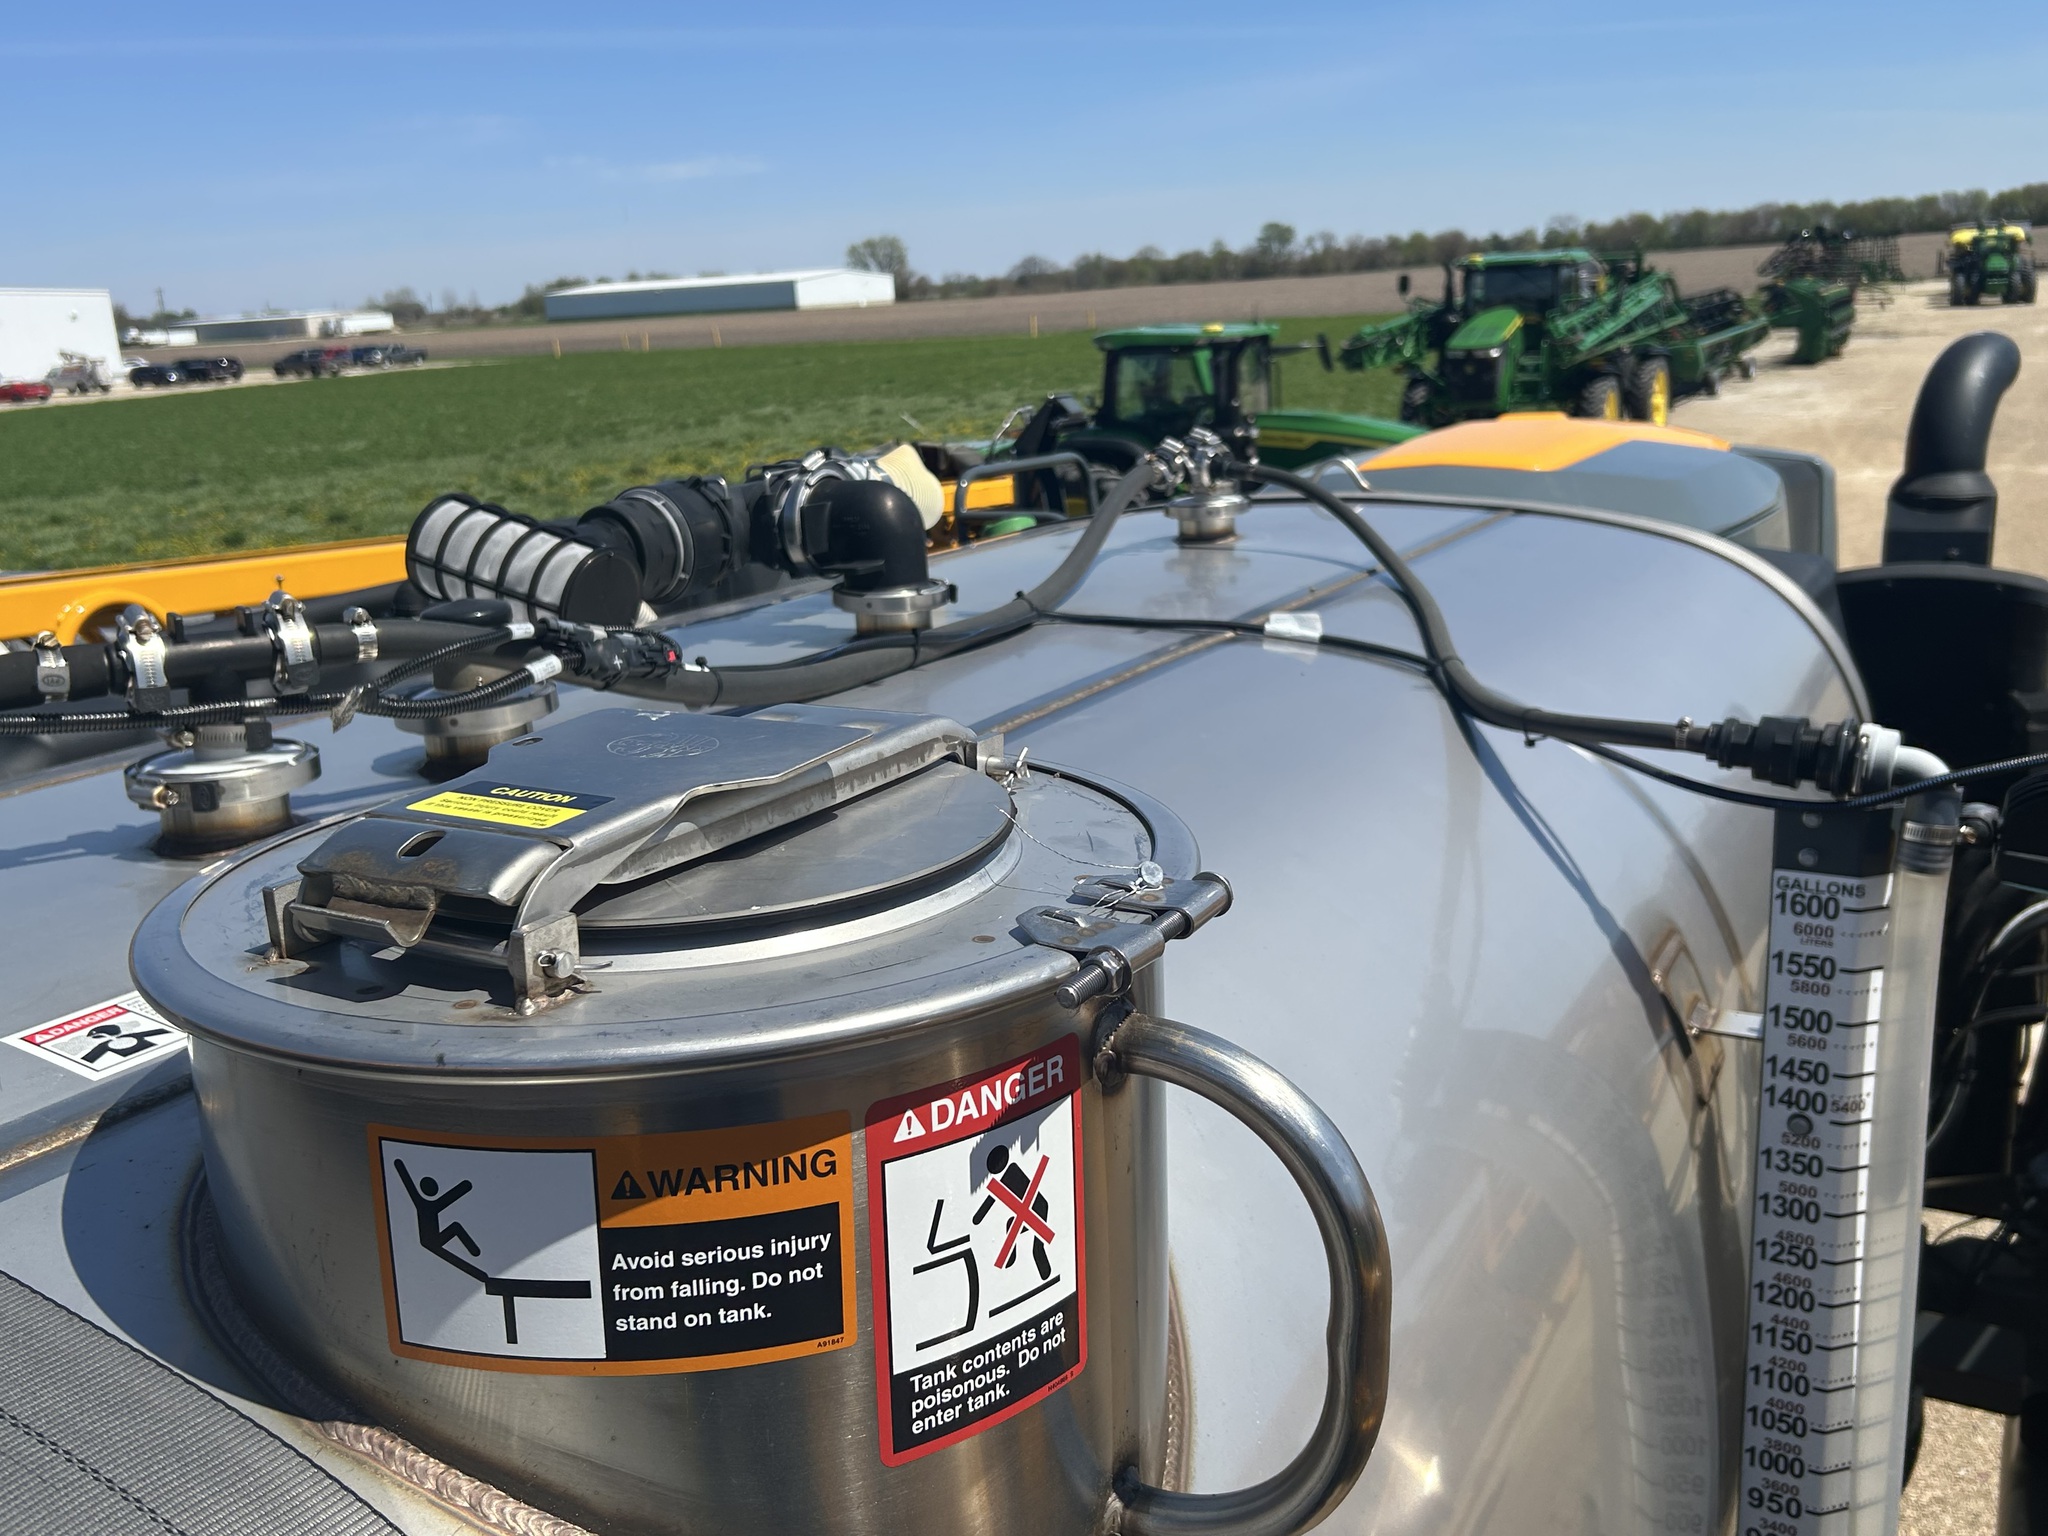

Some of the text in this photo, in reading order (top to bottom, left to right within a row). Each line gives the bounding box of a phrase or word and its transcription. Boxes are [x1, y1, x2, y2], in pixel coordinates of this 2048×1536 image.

[479, 798, 525, 808] PRESSURE
[526, 804, 561, 813] COVER
[490, 786, 577, 804] CAUTION
[1776, 875, 1867, 899] GALLONS
[1774, 891, 1840, 920] 1600
[1793, 921, 1834, 939] 6000
[1800, 937, 1834, 948] LITERS
[1772, 950, 1837, 980] 1550
[1790, 980, 1831, 997] 5800
[49, 1006, 125, 1037] DANGER
[1768, 1003, 1833, 1034] 1500
[1786, 1033, 1827, 1051] 5600
[1766, 1054, 1830, 1085] 1450
[930, 1054, 1064, 1133] DANGER
[1763, 1083, 1828, 1115] 1400
[1830, 1100, 1866, 1114] 5400
[1781, 1131, 1821, 1149] 5200
[646, 1148, 837, 1198] WARNING
[1760, 1146, 1823, 1178] 1350
[1778, 1180, 1818, 1198] 5000
[1758, 1192, 1821, 1224] 1300
[611, 1232, 832, 1271] Avoid serious injury
[1775, 1229, 1815, 1247] 4800
[1756, 1237, 1818, 1270] 1250
[613, 1262, 824, 1301] from falling. Do not
[1772, 1271, 1812, 1289] 4600
[1753, 1280, 1816, 1313] 1200
[615, 1302, 772, 1332] stand on tank.
[1769, 1313, 1811, 1331] 4400
[816, 1336, 845, 1348] A91847
[909, 1311, 1064, 1393] Tank contents are
[1751, 1322, 1813, 1356] 1150
[911, 1327, 1066, 1419] poisonous. Do not
[1768, 1355, 1808, 1374] 4200
[1749, 1364, 1811, 1397] 1100
[911, 1383, 1010, 1435] enter tank.
[1765, 1397, 1805, 1415] 4000
[1746, 1405, 1808, 1438] 1050
[1763, 1437, 1802, 1455] 3800
[1744, 1446, 1806, 1479] 1000
[1761, 1477, 1800, 1496] 3600
[1747, 1486, 1802, 1519] 950
[1759, 1517, 1798, 1536] 3400
